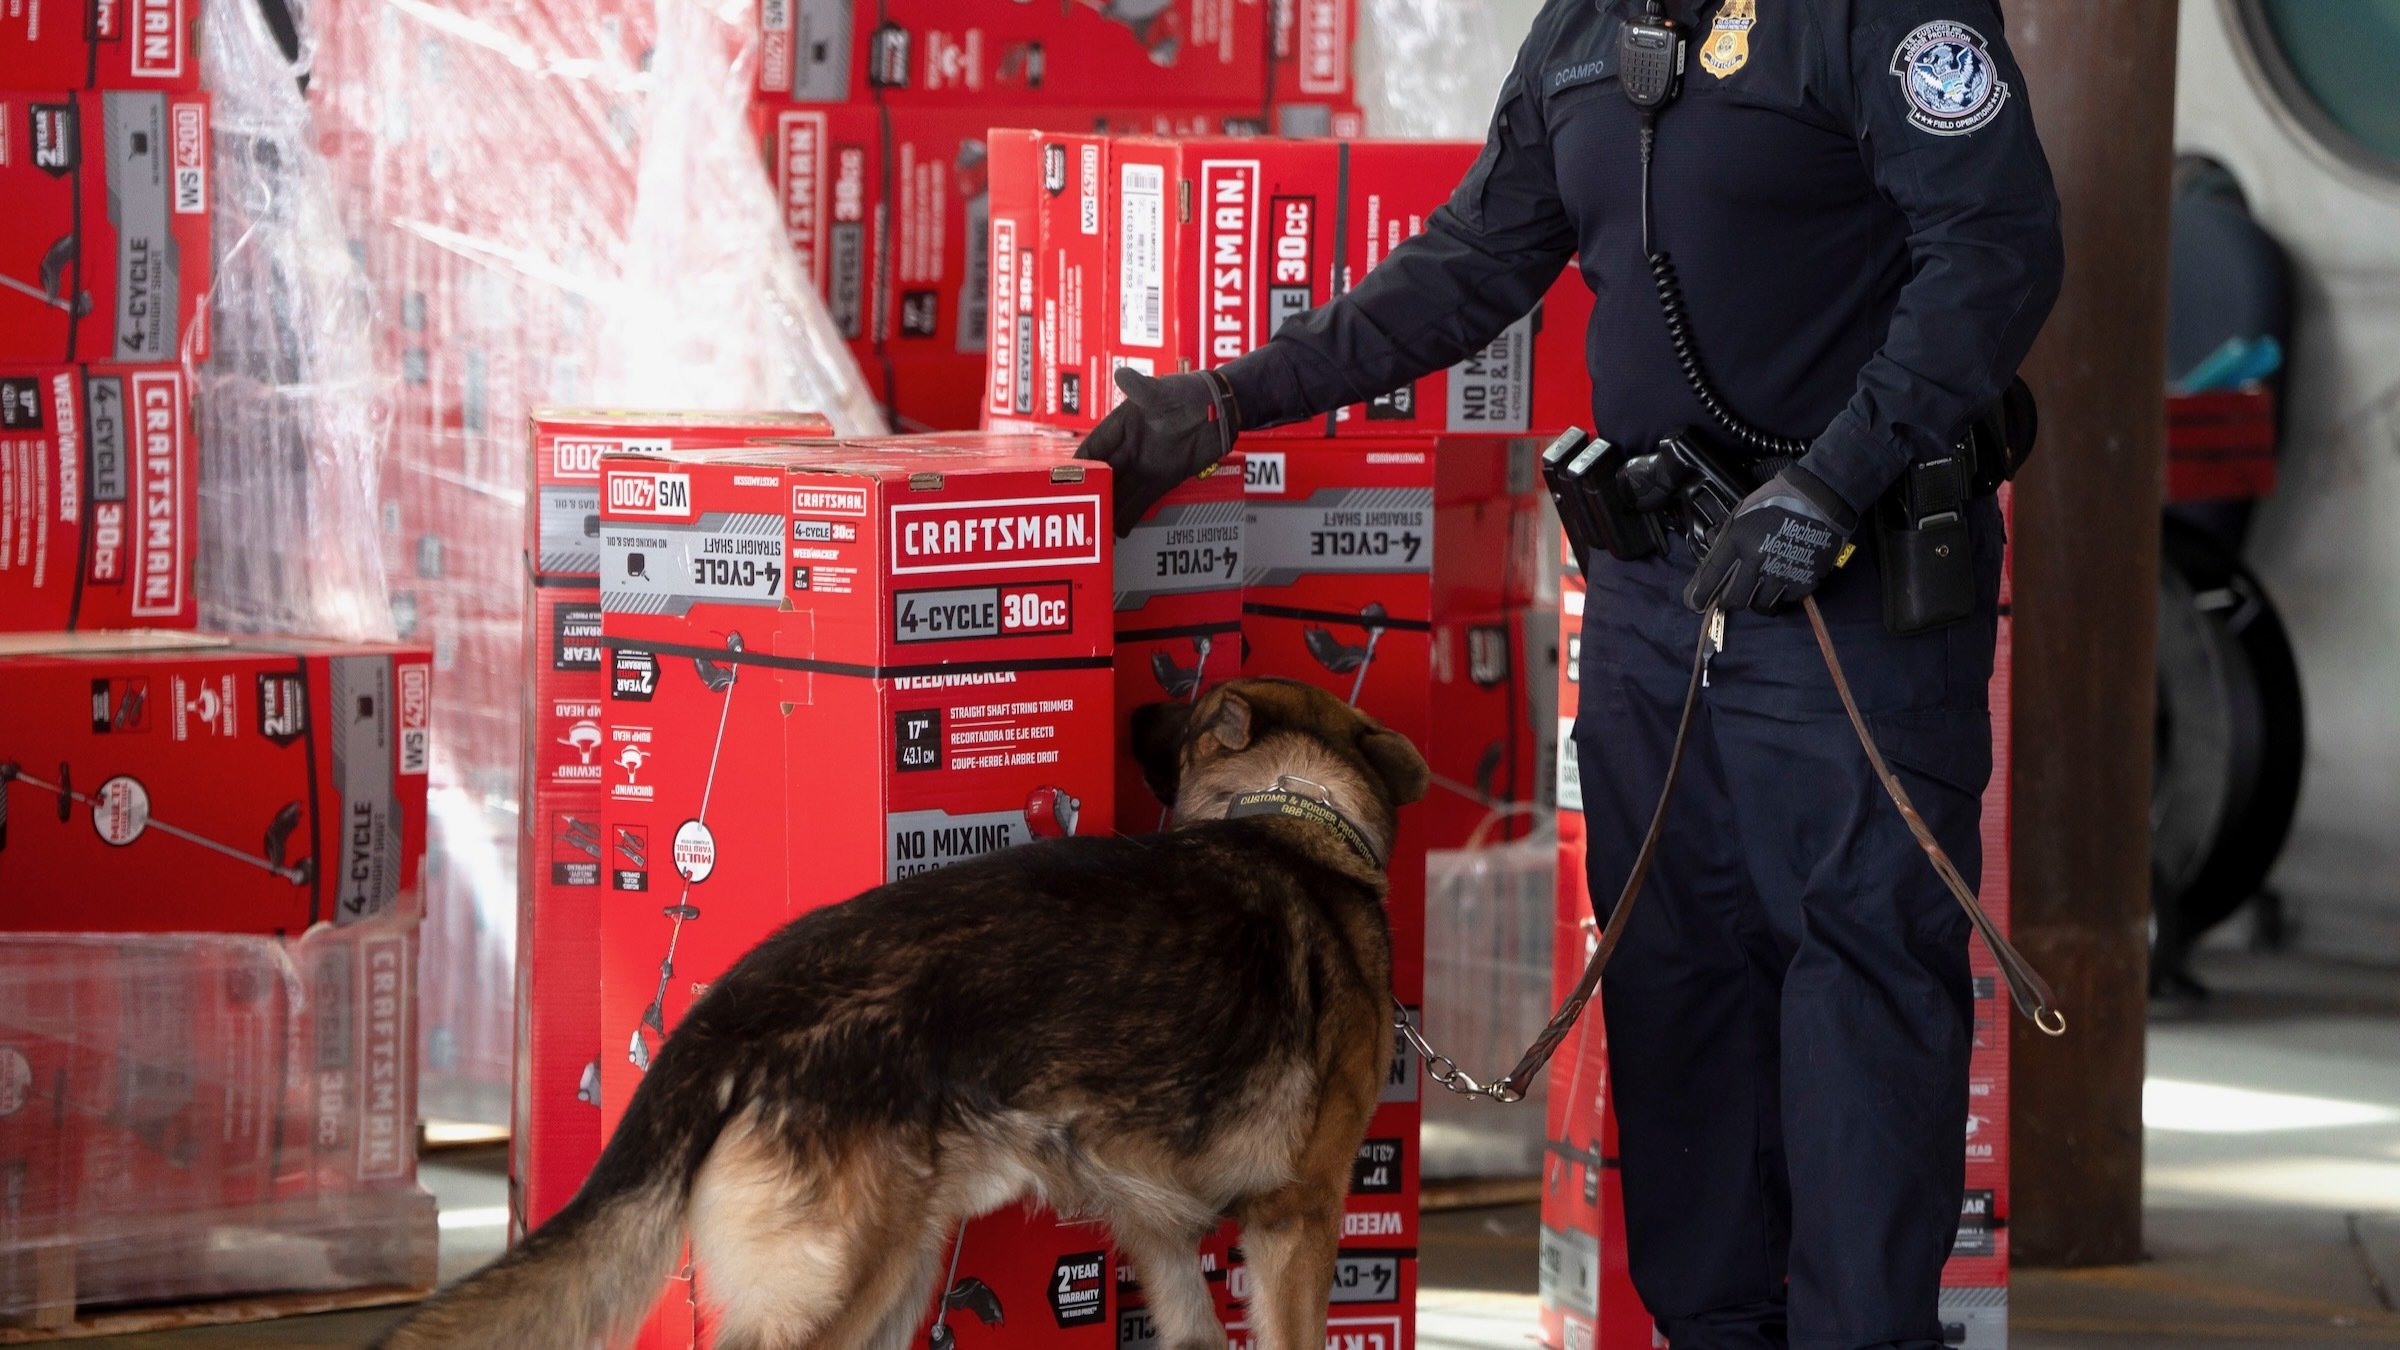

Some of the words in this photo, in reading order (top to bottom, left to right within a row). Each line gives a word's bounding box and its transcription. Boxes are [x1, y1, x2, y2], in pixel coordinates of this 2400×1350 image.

[1917, 24, 1951, 39] CUSTOMS
[1904, 37, 1928, 62] BORDER
[1928, 31, 1971, 43] PROTECTION
[1555, 61, 1604, 86] OCAMPO
[1933, 121, 1954, 129] FIELD
[1955, 103, 1994, 128] OPERATIONS
[180, 170, 199, 208] WS
[1085, 200, 1095, 228] WS
[1277, 203, 1309, 282] 30cc
[1213, 179, 1245, 362] AFTSMAN
[122, 237, 149, 350] 4-CYCLE
[994, 233, 1012, 402] CRAFTSMAN
[1463, 385, 1487, 420] NO
[1490, 384, 1508, 420] GAS
[96, 387, 117, 496] 4-CYCLE
[1245, 461, 1280, 486] WS
[144, 387, 172, 600] CRAFTSMAN
[612, 478, 654, 508] 4200
[660, 480, 688, 508] WS
[797, 493, 861, 508] CRAFTSMAN
[795, 522, 830, 538] 4-CYCLE
[832, 524, 855, 540] 30cc
[1323, 512, 1362, 526] SHAFT
[1367, 512, 1422, 527] STRAIGHT
[94, 505, 121, 580] 30cc
[606, 537, 616, 546] OIL
[622, 538, 636, 547] GAS
[635, 538, 658, 547] MIXING
[658, 540, 667, 548] NO
[703, 537, 734, 553] SHAFT
[905, 513, 1085, 556] CRAFTSMAN
[1166, 529, 1195, 546] SHAFT
[1197, 526, 1239, 542] STRAIGHT
[1776, 517, 1833, 548] Mechanix
[734, 538, 781, 556] STRAIGHT
[1310, 531, 1422, 563] 4-CYCLE
[1758, 533, 1816, 566] Mechanix
[1156, 547, 1238, 579] 4-CYCLE
[1760, 555, 1815, 584] Mechanix
[694, 557, 781, 596] 4-CYCLE
[900, 599, 994, 633] 4-CYCLE
[1004, 593, 1066, 628] 30cc
[563, 625, 601, 636] RRANTY
[617, 660, 652, 670] WARRANTY
[617, 679, 641, 691] YEAR
[641, 671, 652, 692] 2
[555, 704, 586, 717] HEAD
[950, 706, 985, 720] STRAIGHT
[986, 703, 1010, 717] SHAFT
[1011, 701, 1038, 715] STRING
[1039, 699, 1074, 713] TRIMMER
[612, 728, 631, 741] HEAD
[631, 729, 651, 743] BUMP
[950, 729, 1004, 745] RECORTADORA
[1005, 728, 1015, 741] DE
[1016, 727, 1030, 740] EJE
[1030, 725, 1054, 739] RECTO
[404, 730, 424, 770] WS
[903, 746, 922, 765] 43.1
[923, 750, 935, 764] CM
[951, 756, 1003, 771] COUPE-HERBE
[1004, 752, 1010, 767] À
[1011, 752, 1036, 766] ARBRE
[1037, 750, 1059, 765] DROIT
[559, 765, 601, 777] CKWIND
[896, 831, 925, 860] NO
[933, 824, 1010, 857] MIXING
[1240, 793, 1287, 805] CUSTOMS
[1288, 795, 1298, 805] &
[1300, 799, 1338, 825] BORDER
[1337, 820, 1377, 866] PROTECTION
[344, 801, 372, 915] 4-CYCLE
[675, 843, 692, 852] TOOL
[676, 852, 712, 865] MULTI
[693, 843, 712, 852] YARD
[368, 951, 395, 1163] CRAFTSMAN
[1057, 1265, 1071, 1293] 2
[1070, 1263, 1099, 1280] YEAR
[1058, 1288, 1100, 1304] WARRANTY
